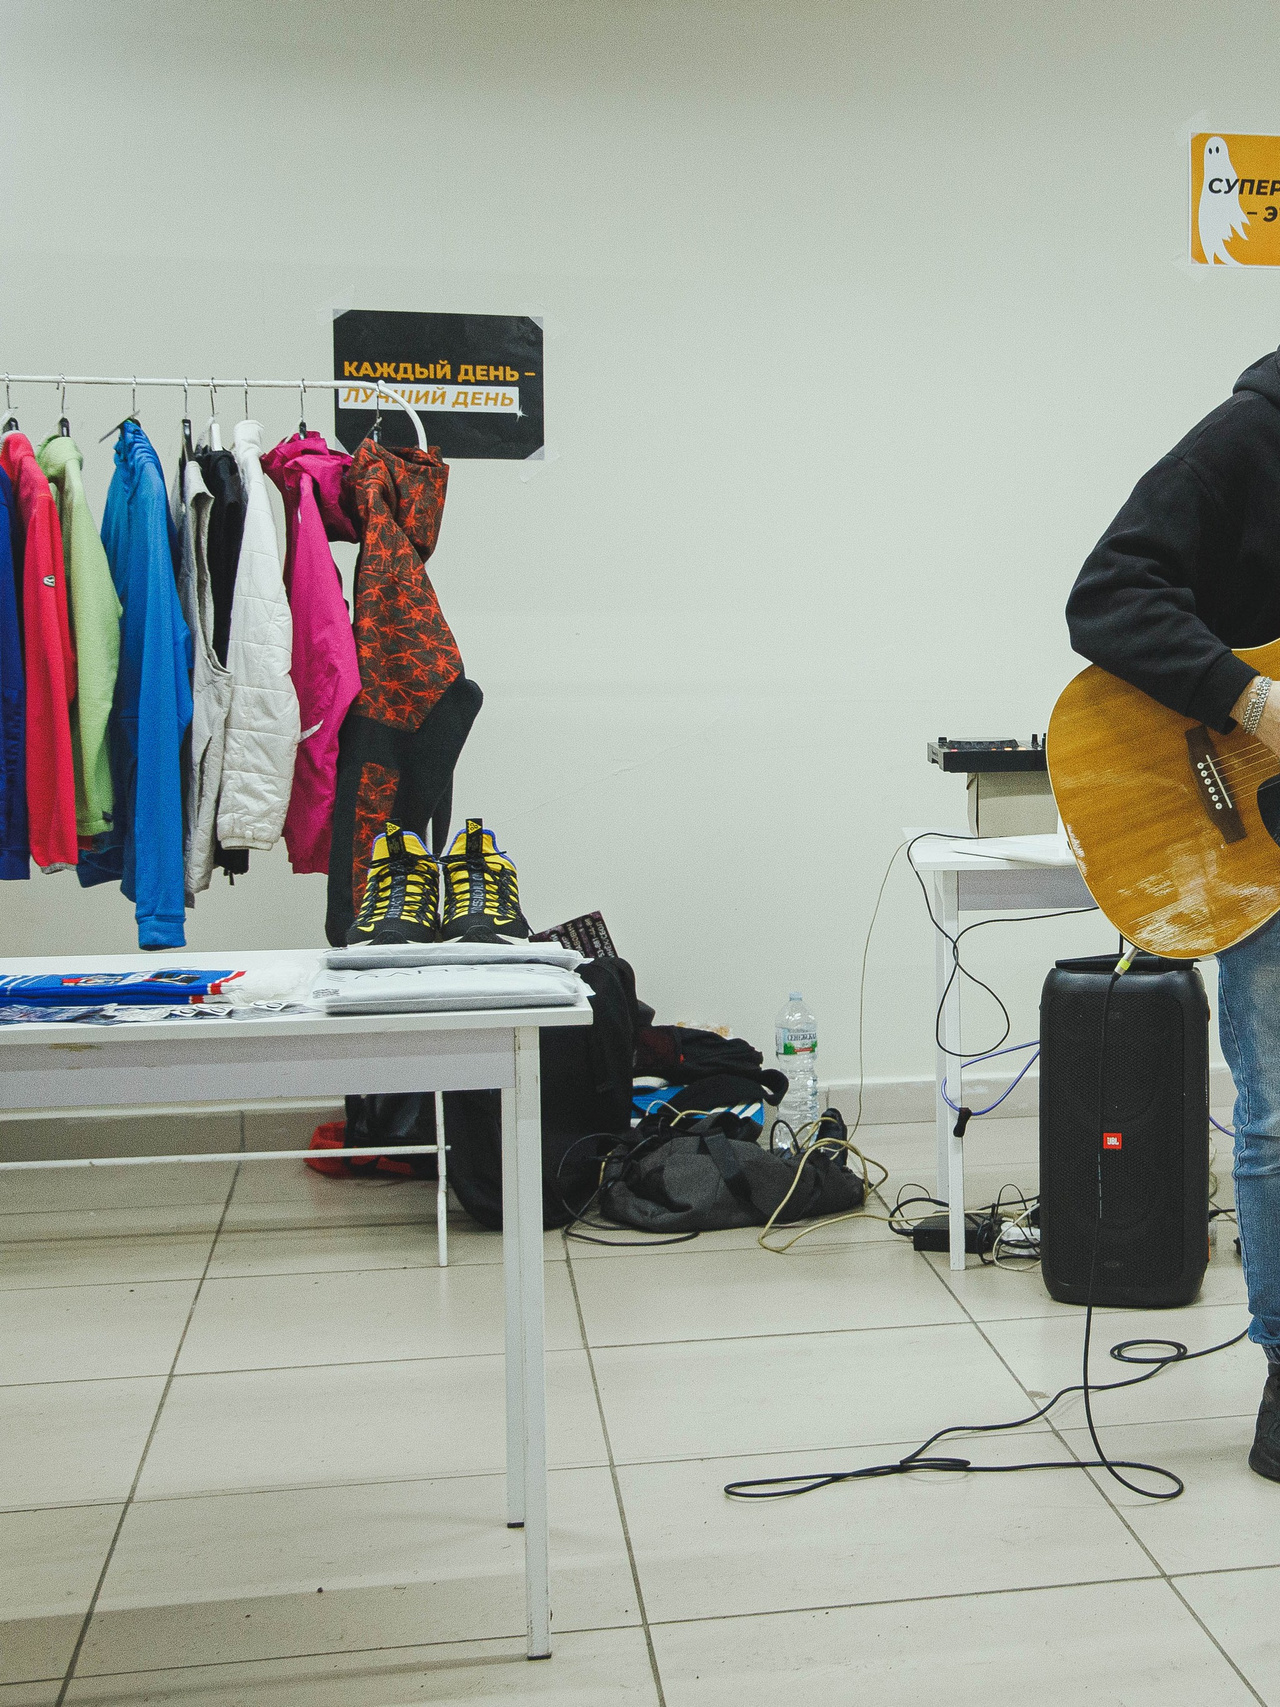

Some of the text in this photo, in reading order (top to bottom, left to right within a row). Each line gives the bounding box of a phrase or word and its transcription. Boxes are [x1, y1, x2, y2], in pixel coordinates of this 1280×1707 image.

[343, 360, 452, 380] КАЖДЫЙ
[458, 365, 519, 382] ДЕНЬ
[452, 390, 513, 408] ДЕНЬ
